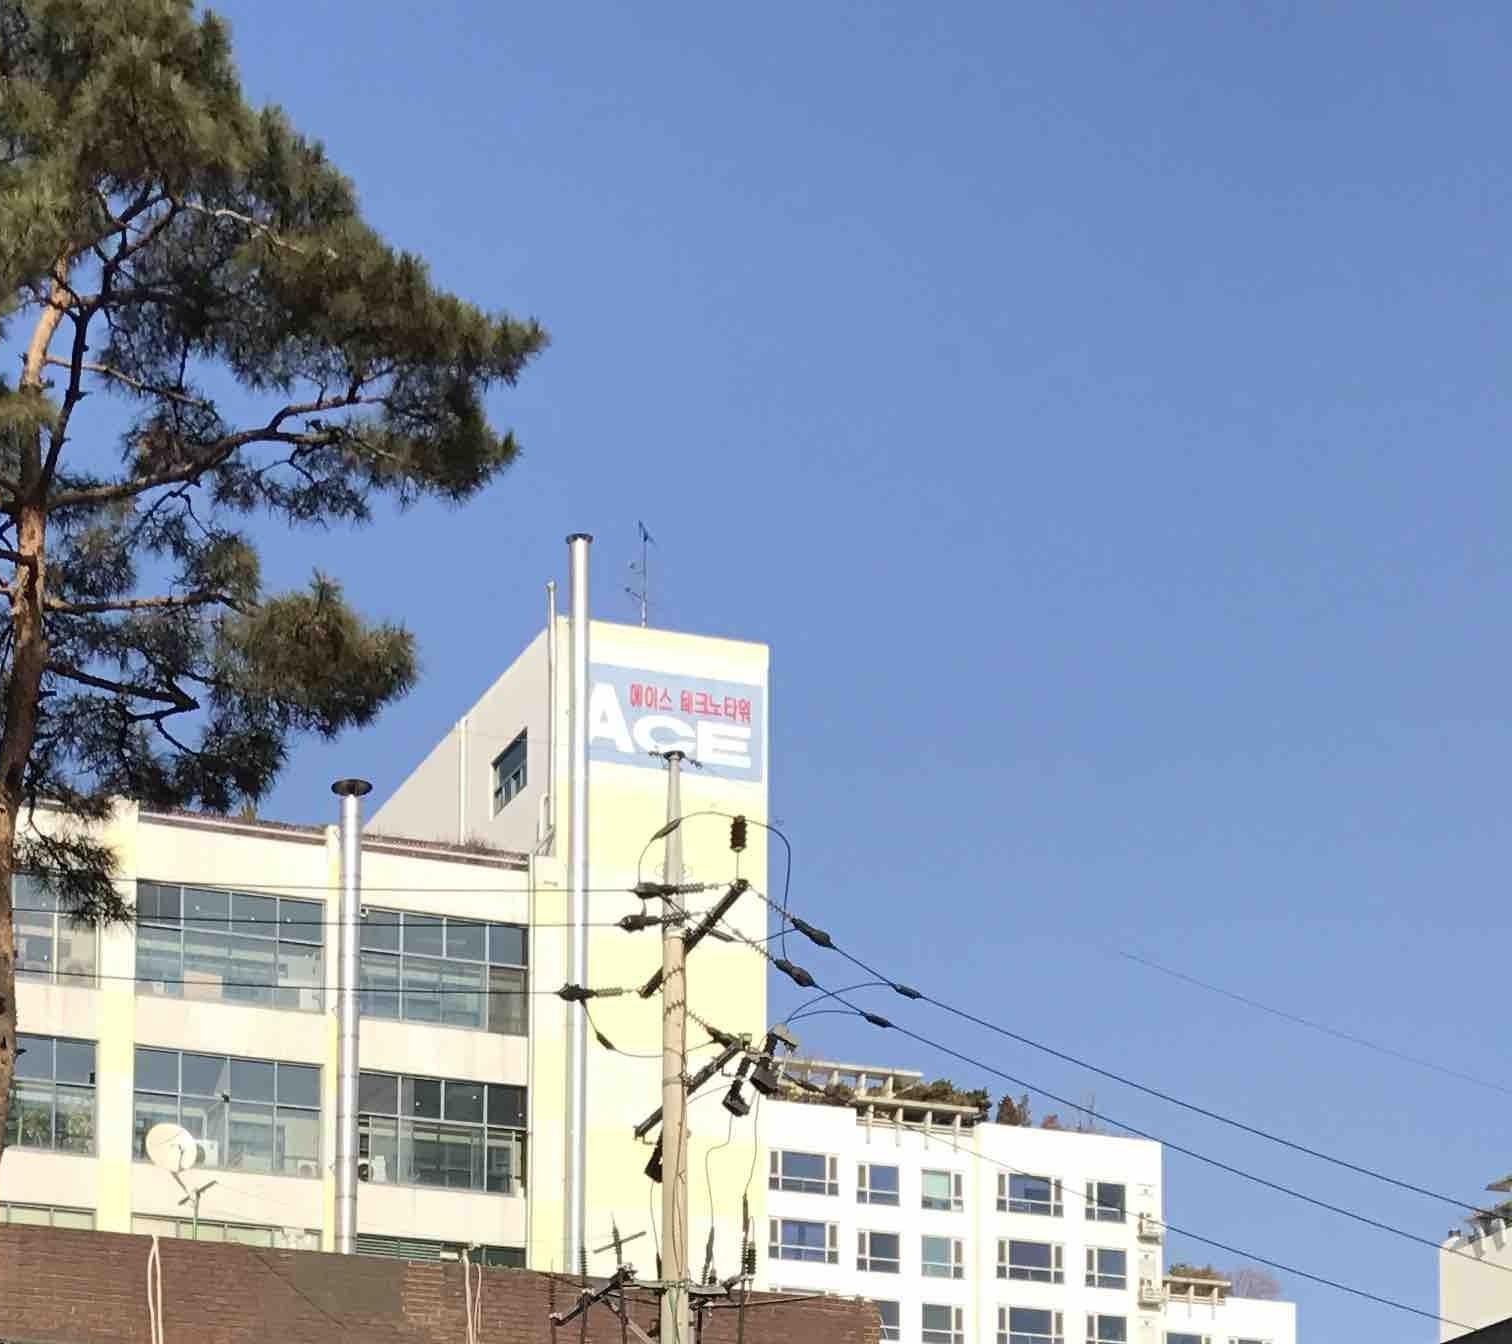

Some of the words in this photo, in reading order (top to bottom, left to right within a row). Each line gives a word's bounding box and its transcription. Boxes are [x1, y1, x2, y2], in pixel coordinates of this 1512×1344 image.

[589, 680, 752, 769] ACE
[629, 682, 674, 712] 에이스
[680, 688, 752, 724] 테크노타워
